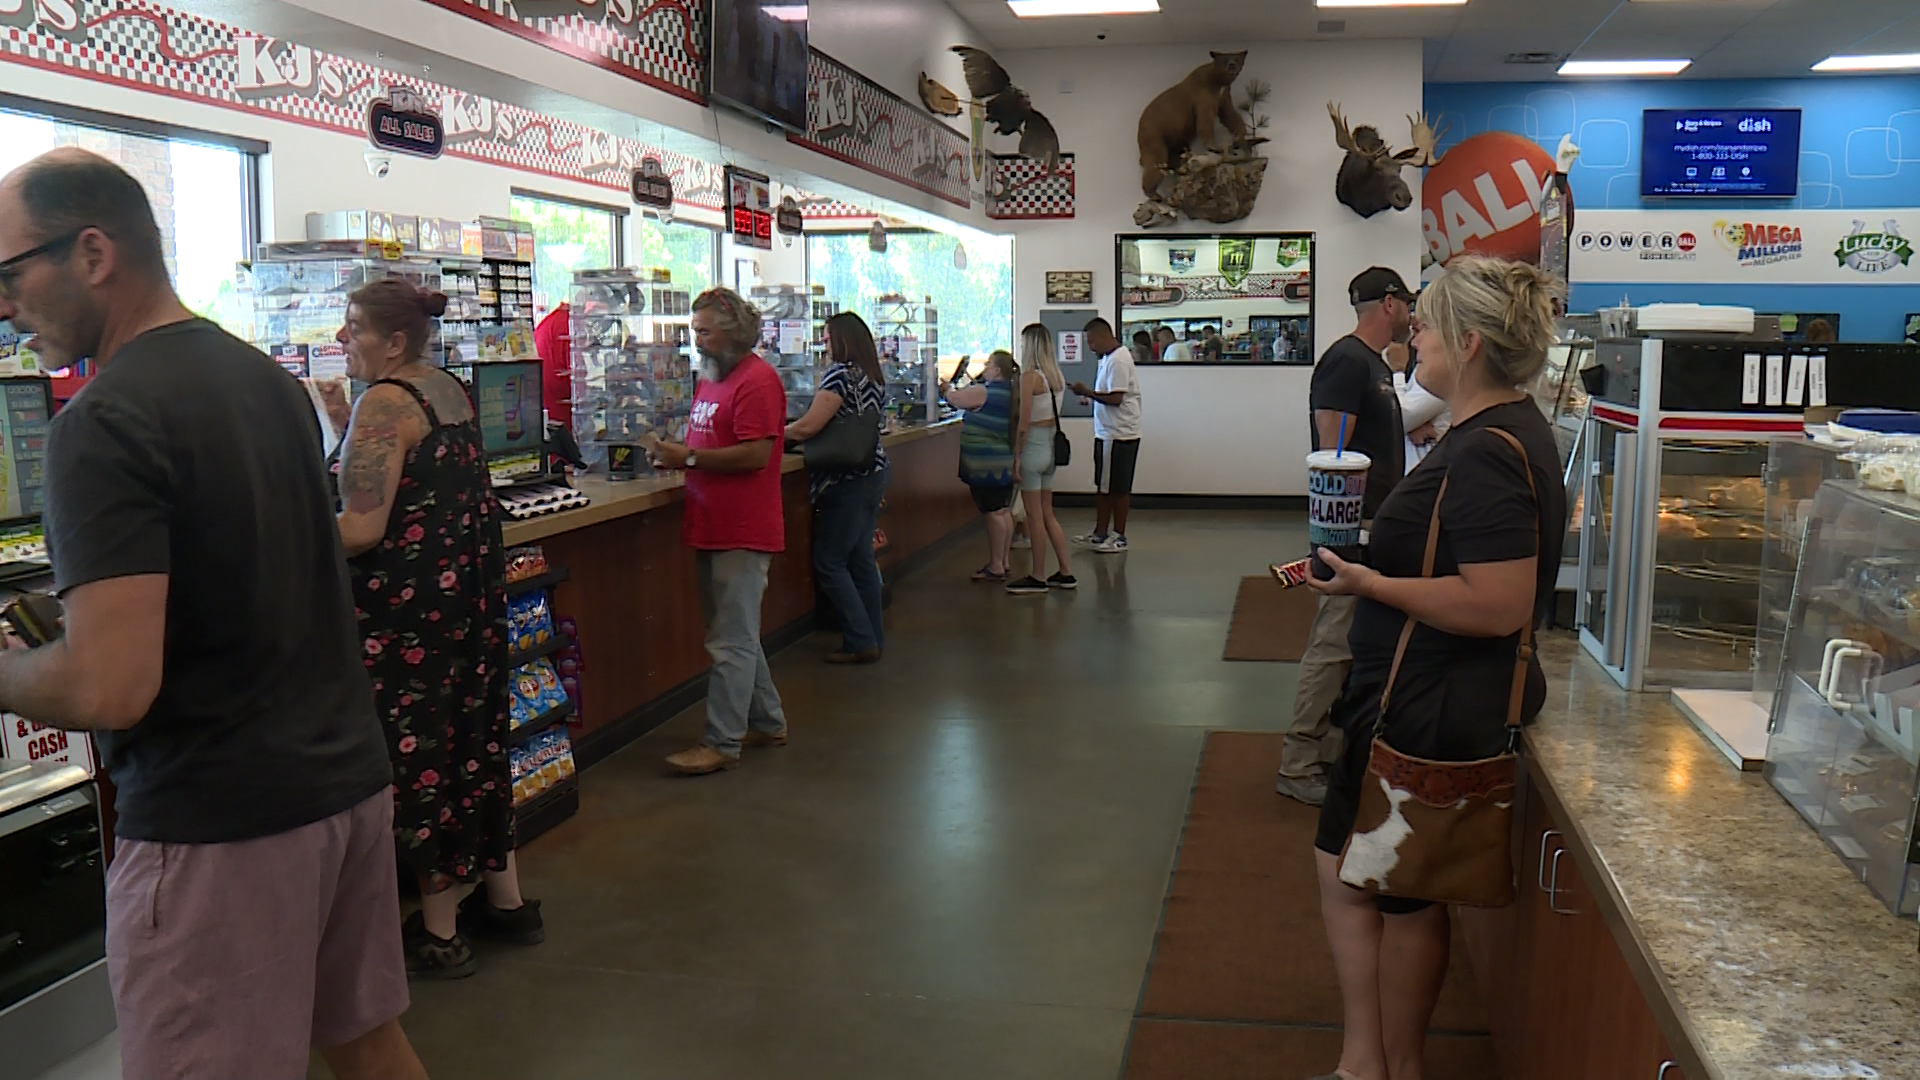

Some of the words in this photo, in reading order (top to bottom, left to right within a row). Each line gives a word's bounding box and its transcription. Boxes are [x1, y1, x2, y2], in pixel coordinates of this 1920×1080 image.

[380, 115, 401, 136] ALL
[403, 121, 435, 144] SALES
[1738, 118, 1772, 132] dish
[1743, 223, 1802, 246] MEGA
[1311, 497, 1361, 524] X-LARGE
[28, 730, 69, 760] CASH
